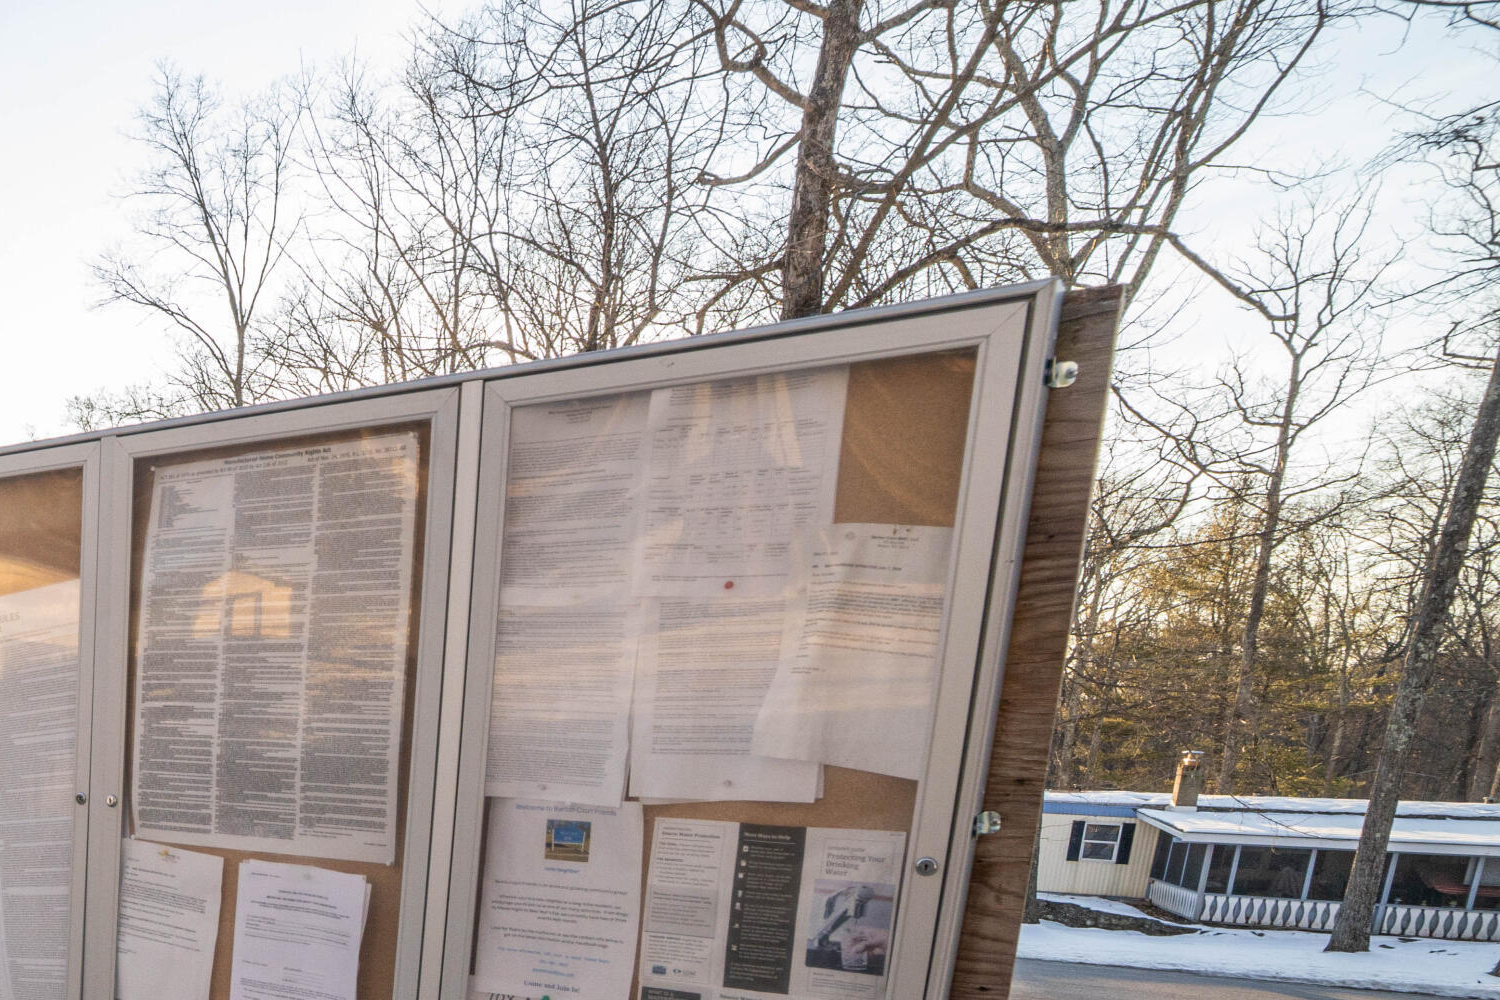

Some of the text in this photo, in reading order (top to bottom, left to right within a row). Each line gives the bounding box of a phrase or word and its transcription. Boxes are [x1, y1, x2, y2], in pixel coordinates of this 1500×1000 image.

[275, 450, 304, 460] Community
[827, 852, 886, 863] Protecting Your
[825, 860, 860, 870] Drinking
[825, 868, 848, 876] Water
[543, 981, 556, 989] and
